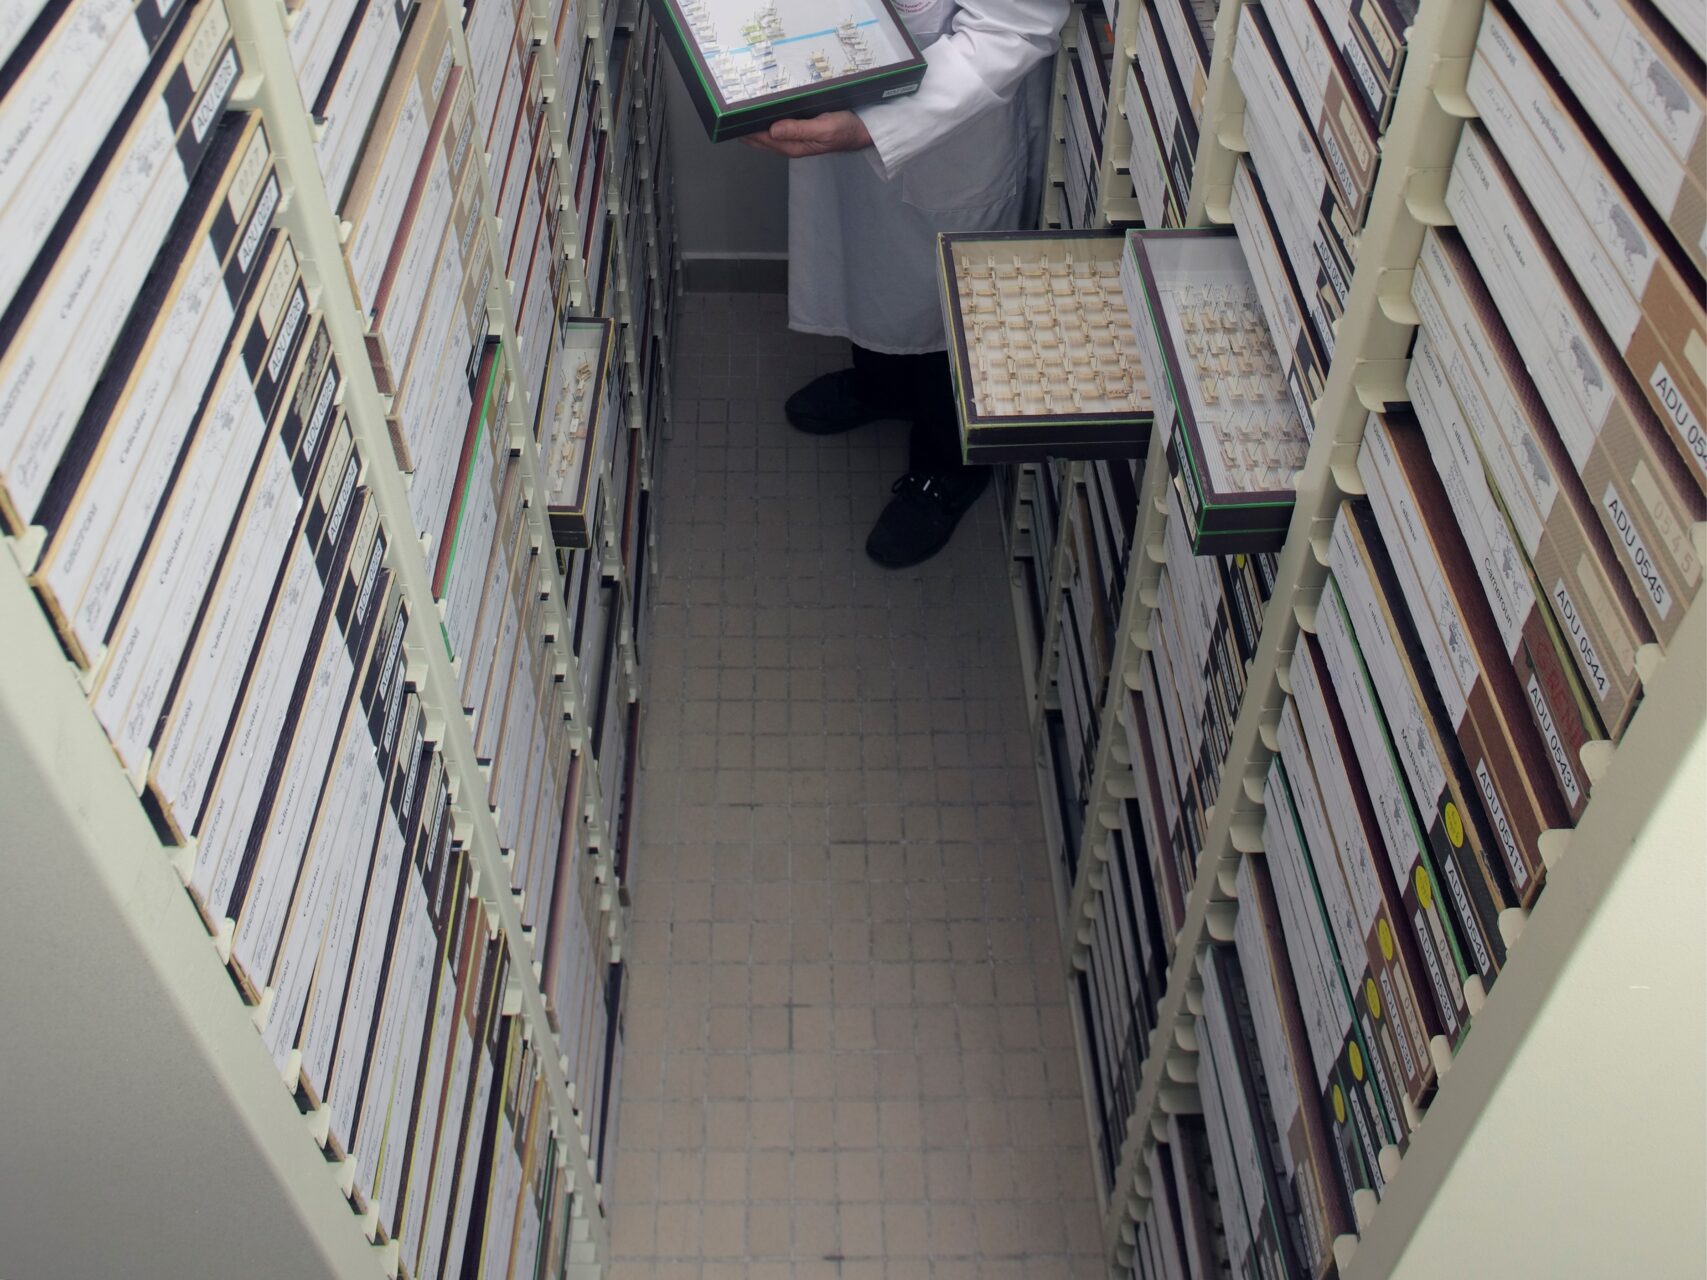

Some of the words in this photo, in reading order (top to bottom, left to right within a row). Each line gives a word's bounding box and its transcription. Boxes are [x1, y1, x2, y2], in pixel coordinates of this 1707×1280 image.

[1347, 34, 1362, 69] ADU
[194, 92, 215, 135] ADU
[1327, 132, 1340, 165] ADU
[1338, 157, 1353, 196] 0515
[240, 220, 259, 265] ADU
[1318, 238, 1333, 268] ADU
[270, 332, 287, 376] ADU
[1656, 377, 1688, 425] ADU
[305, 412, 321, 455] ADU
[329, 500, 344, 542] ADU
[1608, 492, 1636, 550] ADU
[1633, 543, 1665, 607] 0545
[359, 580, 370, 619] ADU
[1484, 557, 1513, 629] Cameroun
[1556, 584, 1581, 637] ADU
[1578, 633, 1606, 692] 0544
[1530, 682, 1551, 734] ADU
[1401, 728, 1433, 810] Madagascar
[1479, 766, 1499, 817] ADU
[1378, 793, 1406, 876] Madagascar
[1447, 863, 1467, 914] ADU
[1465, 911, 1487, 968] 0540
[1418, 920, 1435, 969] ADU
[1433, 967, 1453, 1022] 0539
[1381, 974, 1397, 1021] ADU
[1367, 1030, 1382, 1075] ADU
